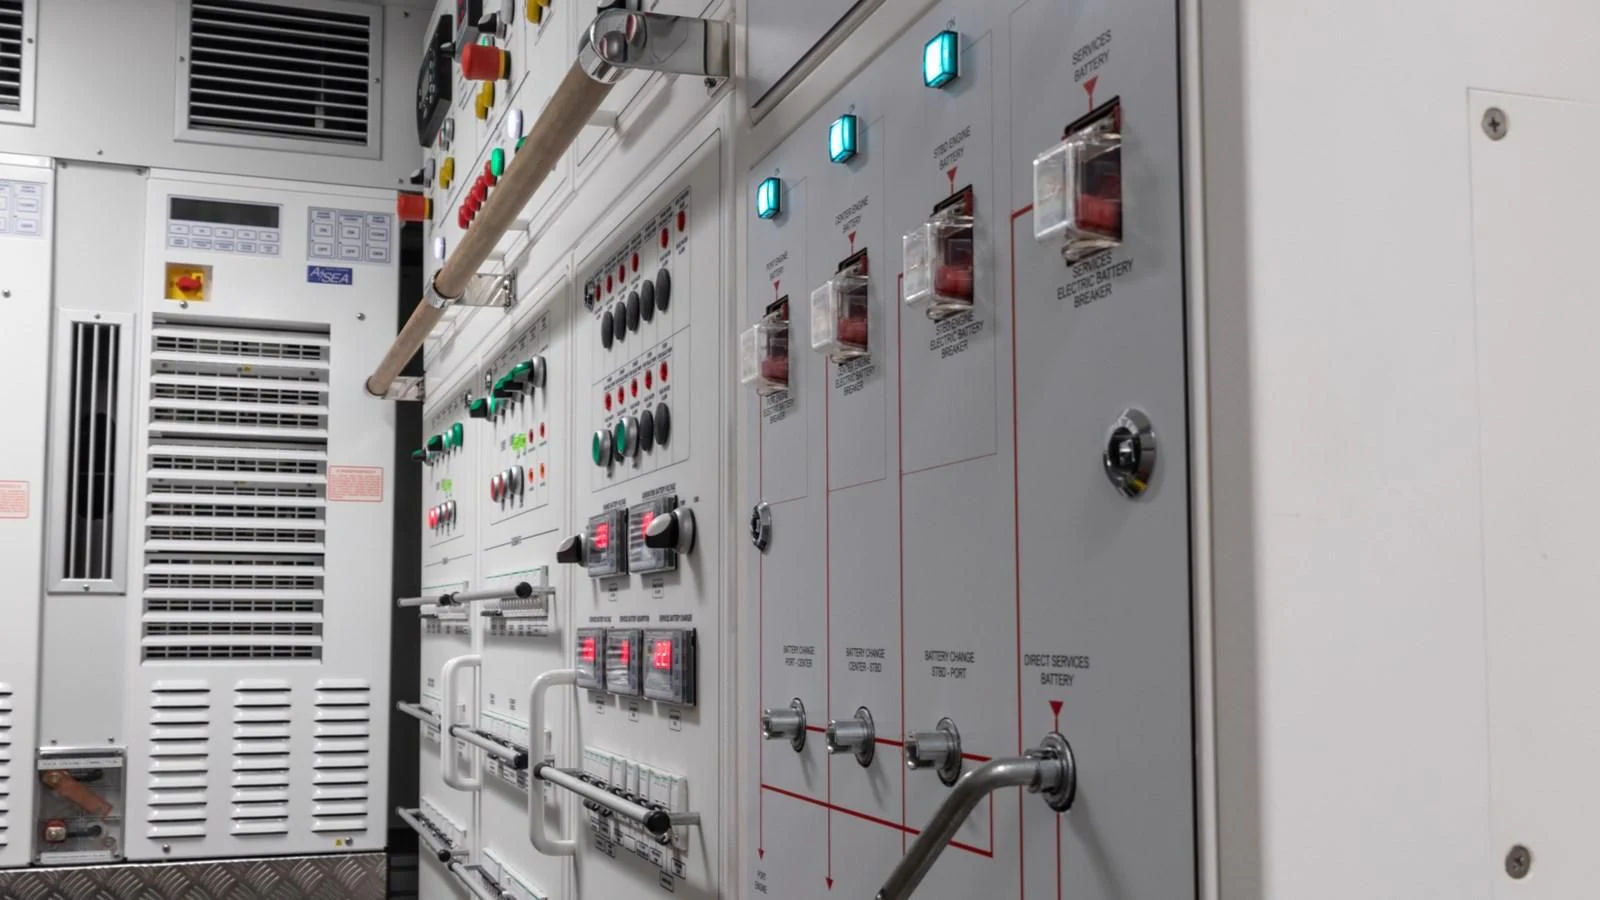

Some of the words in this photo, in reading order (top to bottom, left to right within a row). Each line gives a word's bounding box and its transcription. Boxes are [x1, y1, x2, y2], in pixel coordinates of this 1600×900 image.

[1072, 29, 1112, 65] SERVICES
[1074, 49, 1110, 82] BATTERY
[949, 124, 971, 149] ENGINE
[939, 147, 964, 171] BATTERY
[1072, 251, 1112, 279] SERVICES
[1056, 274, 1095, 300] ELECTRIC
[1096, 257, 1133, 284] BATTERY
[1074, 283, 1112, 308] BREAKER
[930, 330, 956, 351] ELECTRIC
[958, 320, 984, 340] BATTERY
[941, 339, 968, 359] BREAKER
[846, 647, 865, 657] BATTERY
[865, 648, 886, 659] CHANGE
[924, 650, 949, 662] BATTERY
[951, 651, 975, 663] CHANGE
[1024, 654, 1050, 667] DIRECT
[1051, 655, 1090, 669] SERVICES
[848, 661, 866, 672] CENTER
[931, 665, 946, 677] STBD
[951, 667, 967, 679] PORT
[1040, 672, 1075, 687] BATTERY
